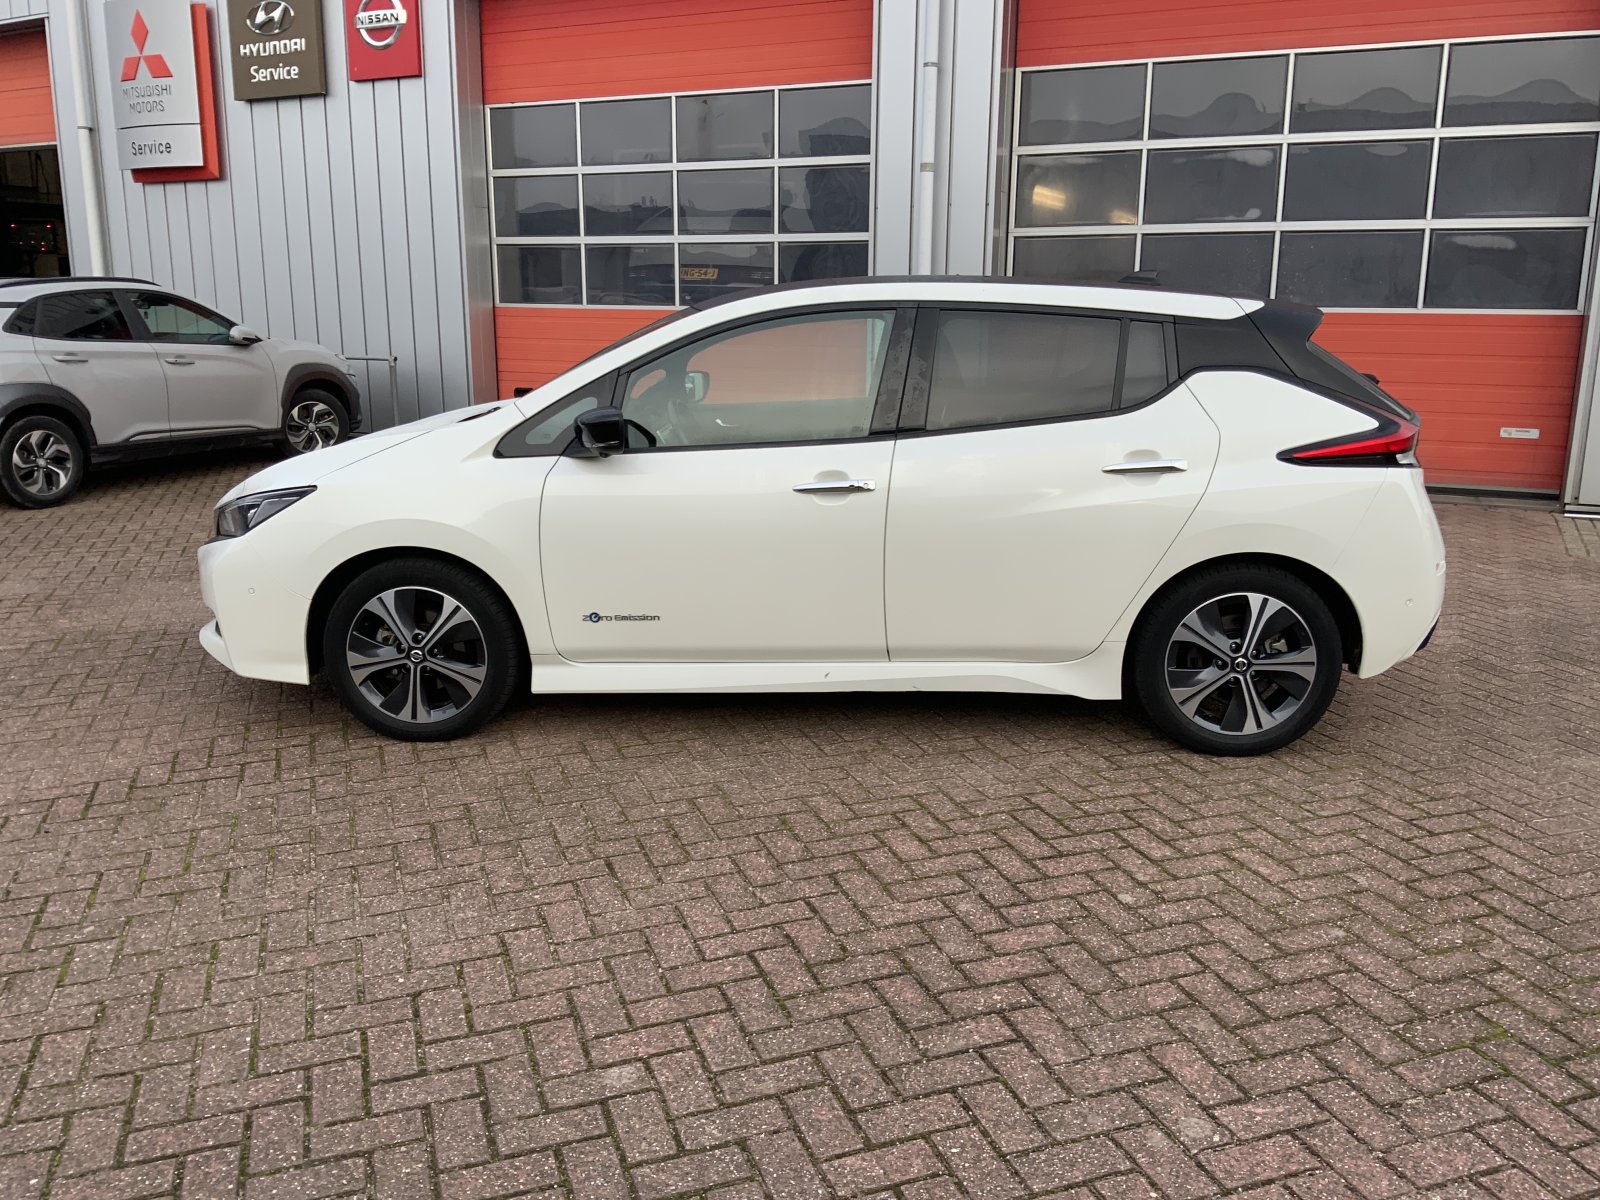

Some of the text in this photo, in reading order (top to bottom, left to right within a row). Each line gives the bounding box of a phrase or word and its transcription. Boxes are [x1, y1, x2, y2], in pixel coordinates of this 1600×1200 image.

[357, 13, 399, 25] NISSAN
[240, 38, 306, 57] HYUNDAI
[250, 63, 299, 83] Service
[122, 84, 172, 98] MITSUBISHI
[129, 99, 165, 114] MOTORS
[131, 139, 172, 156] Service
[614, 613, 661, 622] Emission
